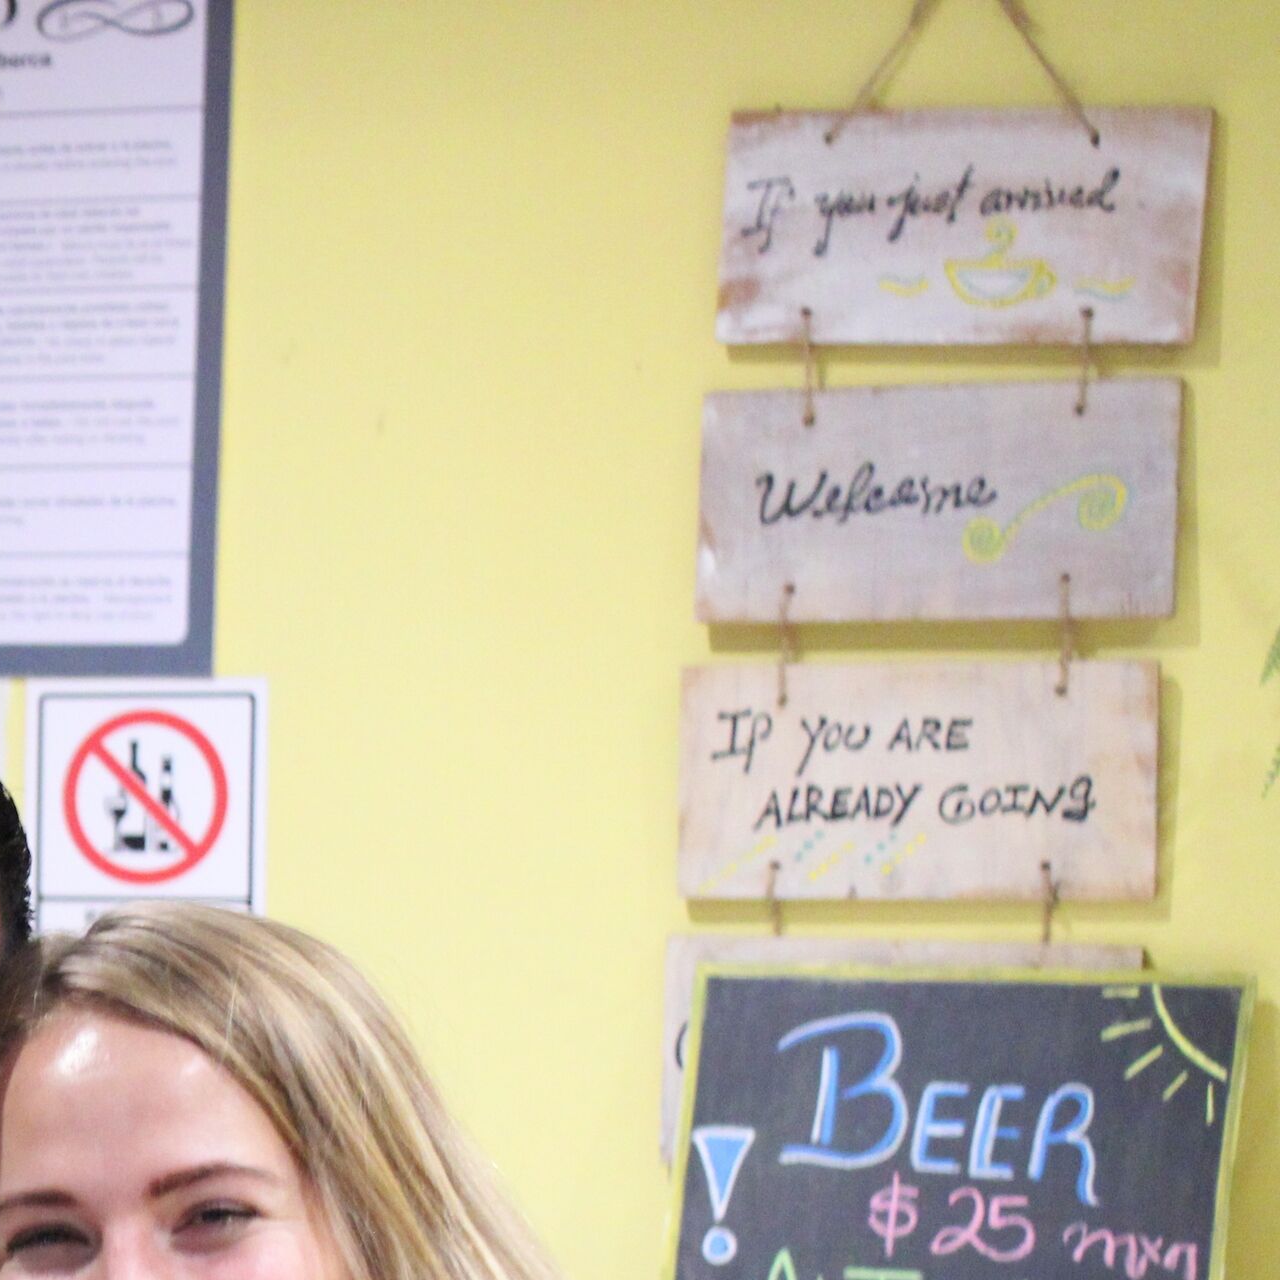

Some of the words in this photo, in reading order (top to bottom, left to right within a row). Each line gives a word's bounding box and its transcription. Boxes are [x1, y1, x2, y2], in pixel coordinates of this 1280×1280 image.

[754, 461, 998, 526] Welcome
[887, 717, 974, 752] ARE
[753, 782, 923, 832] ALREADY
